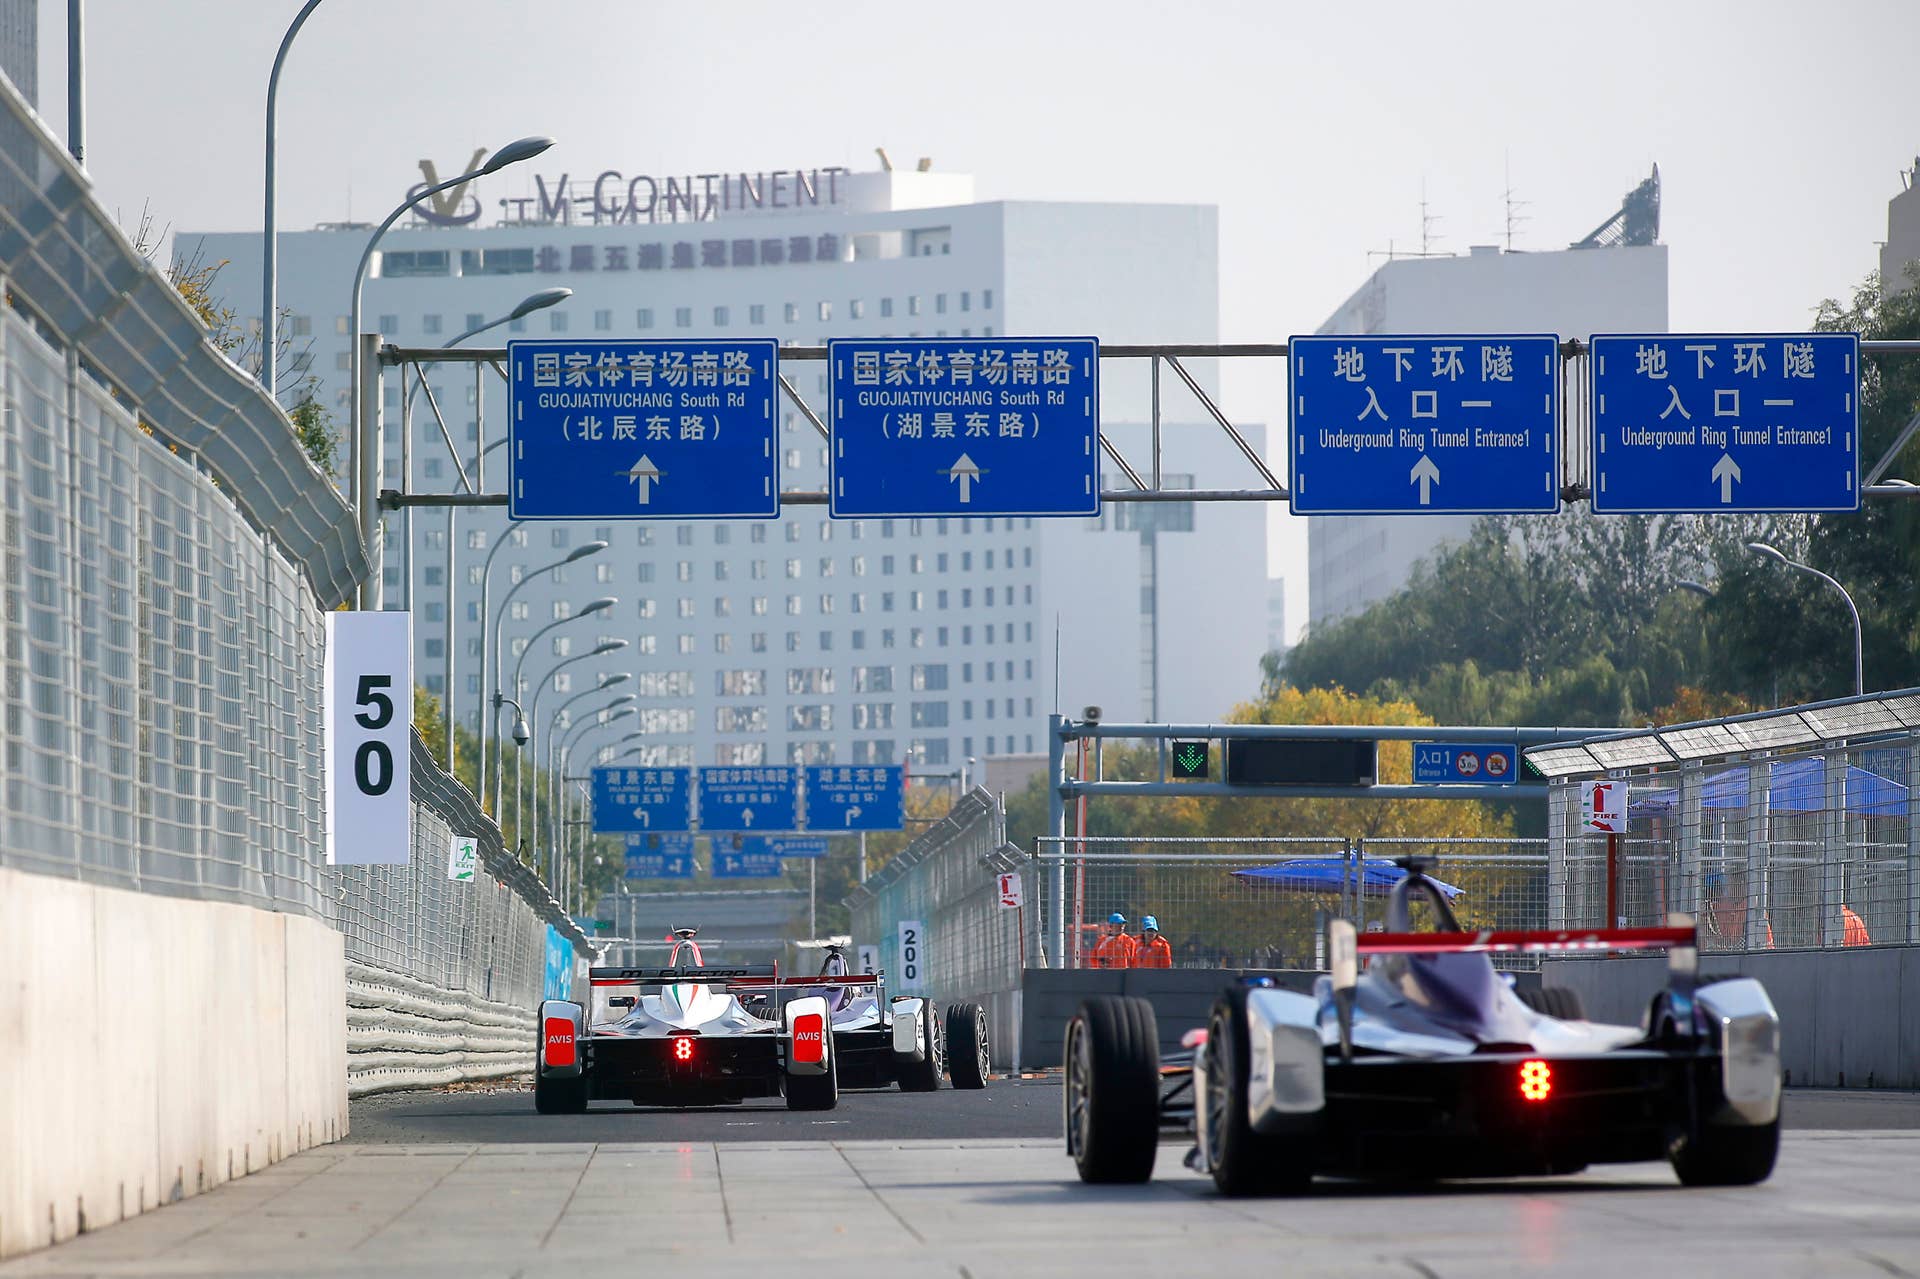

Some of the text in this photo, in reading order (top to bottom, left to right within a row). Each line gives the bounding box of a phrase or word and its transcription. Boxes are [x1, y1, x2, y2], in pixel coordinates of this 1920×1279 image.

[594, 167, 843, 213] CONTINENT
[533, 350, 752, 388] 国家体育场南路
[853, 348, 1071, 386] 国家体育场南路
[1333, 345, 1513, 382] 地下环隧
[1635, 342, 1815, 380] 地下环隧
[538, 392, 745, 408] GUOJIATIYUCHANG South Rd
[858, 390, 1065, 406] GUOJIATIYUCHANG South Rd
[1357, 386, 1492, 421] 入口一
[1659, 384, 1794, 420] 入口一
[1319, 428, 1530, 452] Underground Ring Tunnel Entrance1
[1621, 426, 1831, 450] Underground Ring Tunnel Entrance1
[354, 675, 394, 796] 50
[904, 929, 917, 980] 200
[548, 1034, 573, 1044] AVIS
[795, 1031, 820, 1041] AVIS
